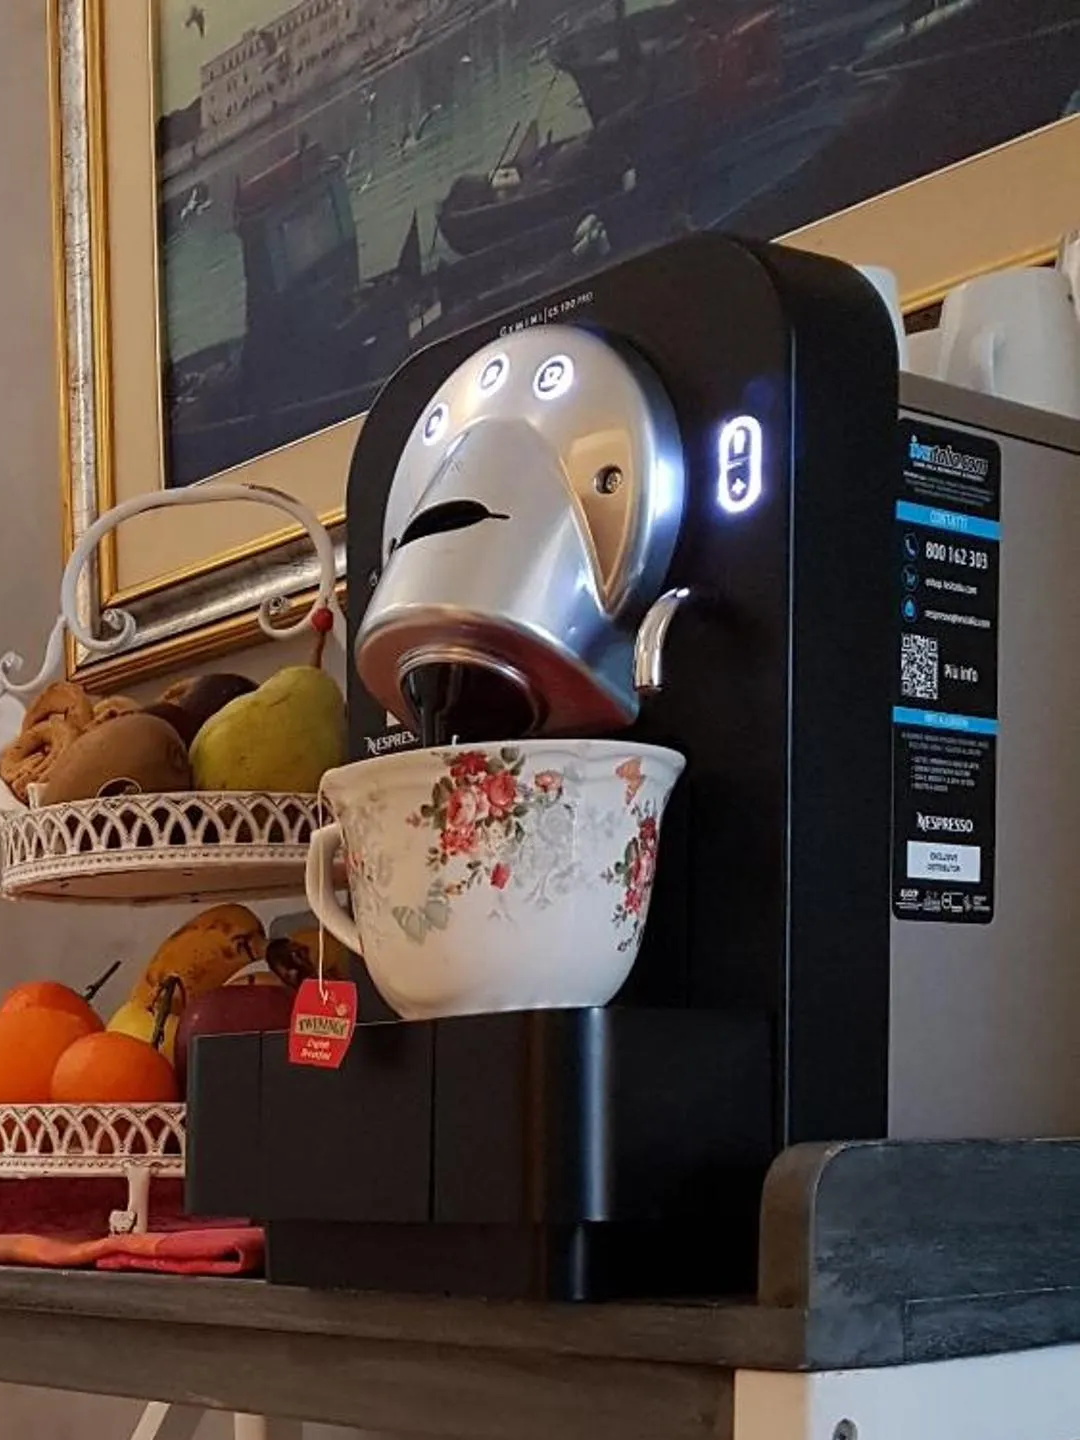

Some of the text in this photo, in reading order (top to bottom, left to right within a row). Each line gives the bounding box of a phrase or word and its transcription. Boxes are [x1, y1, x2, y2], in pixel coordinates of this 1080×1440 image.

[925, 541, 988, 570] 800 162 303
[363, 730, 419, 756] NESPRES
[916, 811, 973, 833] NESPRESSO
